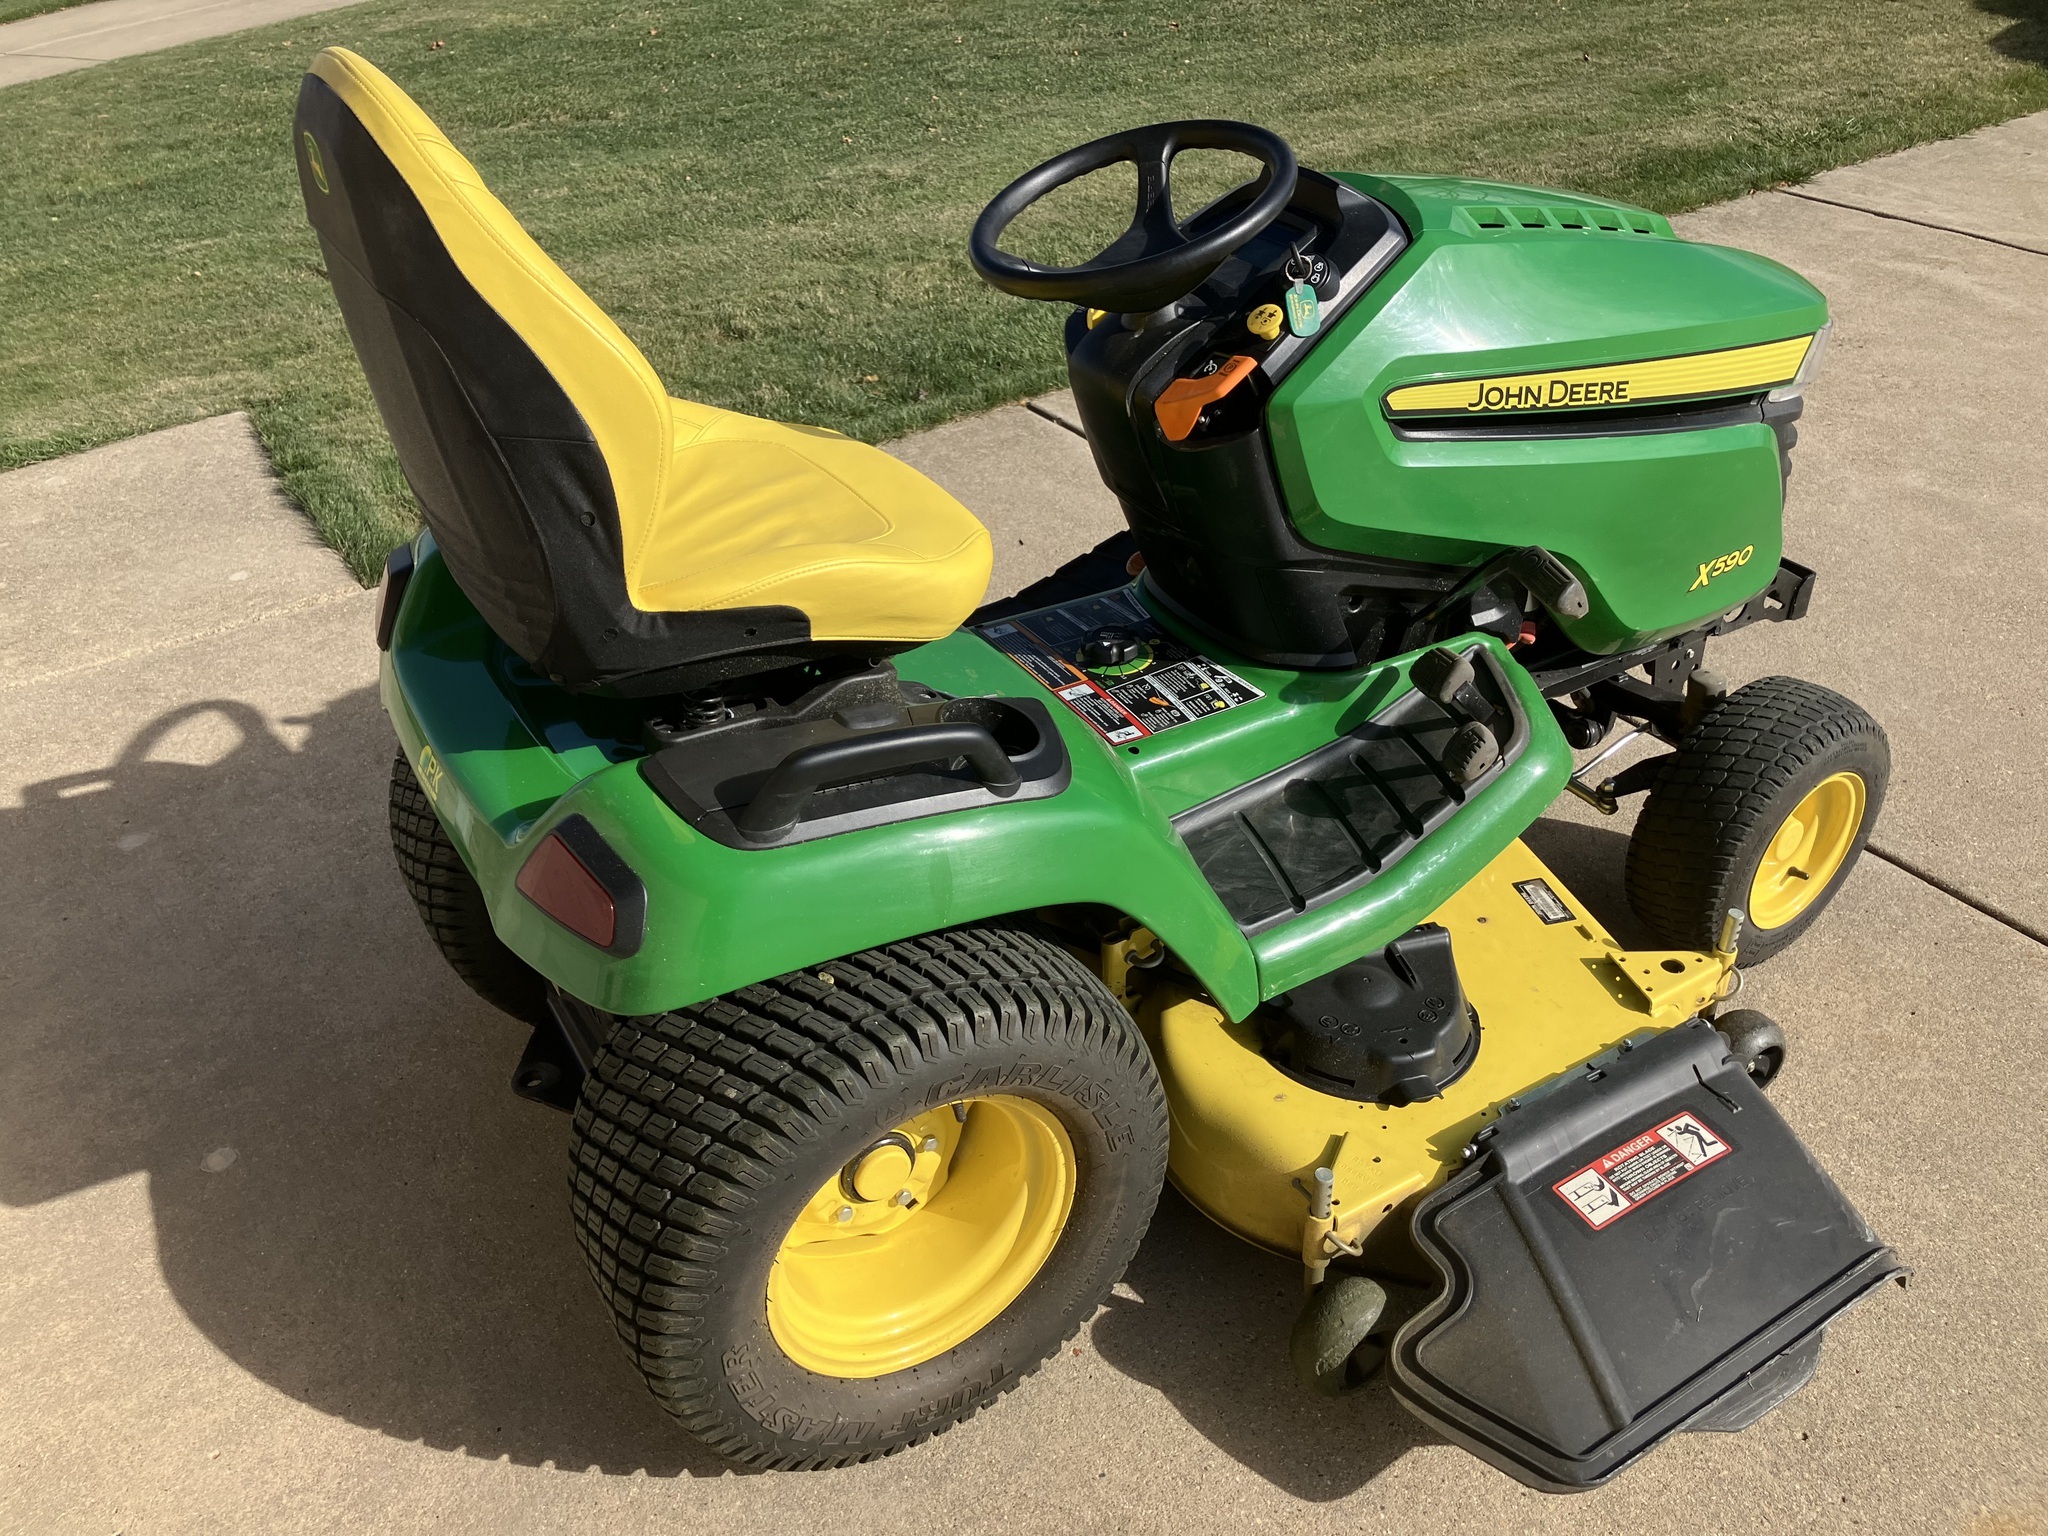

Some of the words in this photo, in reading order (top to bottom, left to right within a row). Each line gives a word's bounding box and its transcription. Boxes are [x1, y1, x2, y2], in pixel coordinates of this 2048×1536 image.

[1468, 383, 1542, 409] JOHN
[1549, 380, 1629, 405] DEERE
[1687, 544, 1754, 592] X590
[925, 1062, 1136, 1153] CARLISLE
[1610, 1135, 1654, 1162] DANGER
[1622, 1166, 1645, 1181] THROWN
[1643, 1153, 1667, 1168] OBJECTS
[1637, 1145, 1655, 1156] BLADE
[720, 1343, 876, 1446] MASTER
[879, 1360, 1013, 1441] TURF
